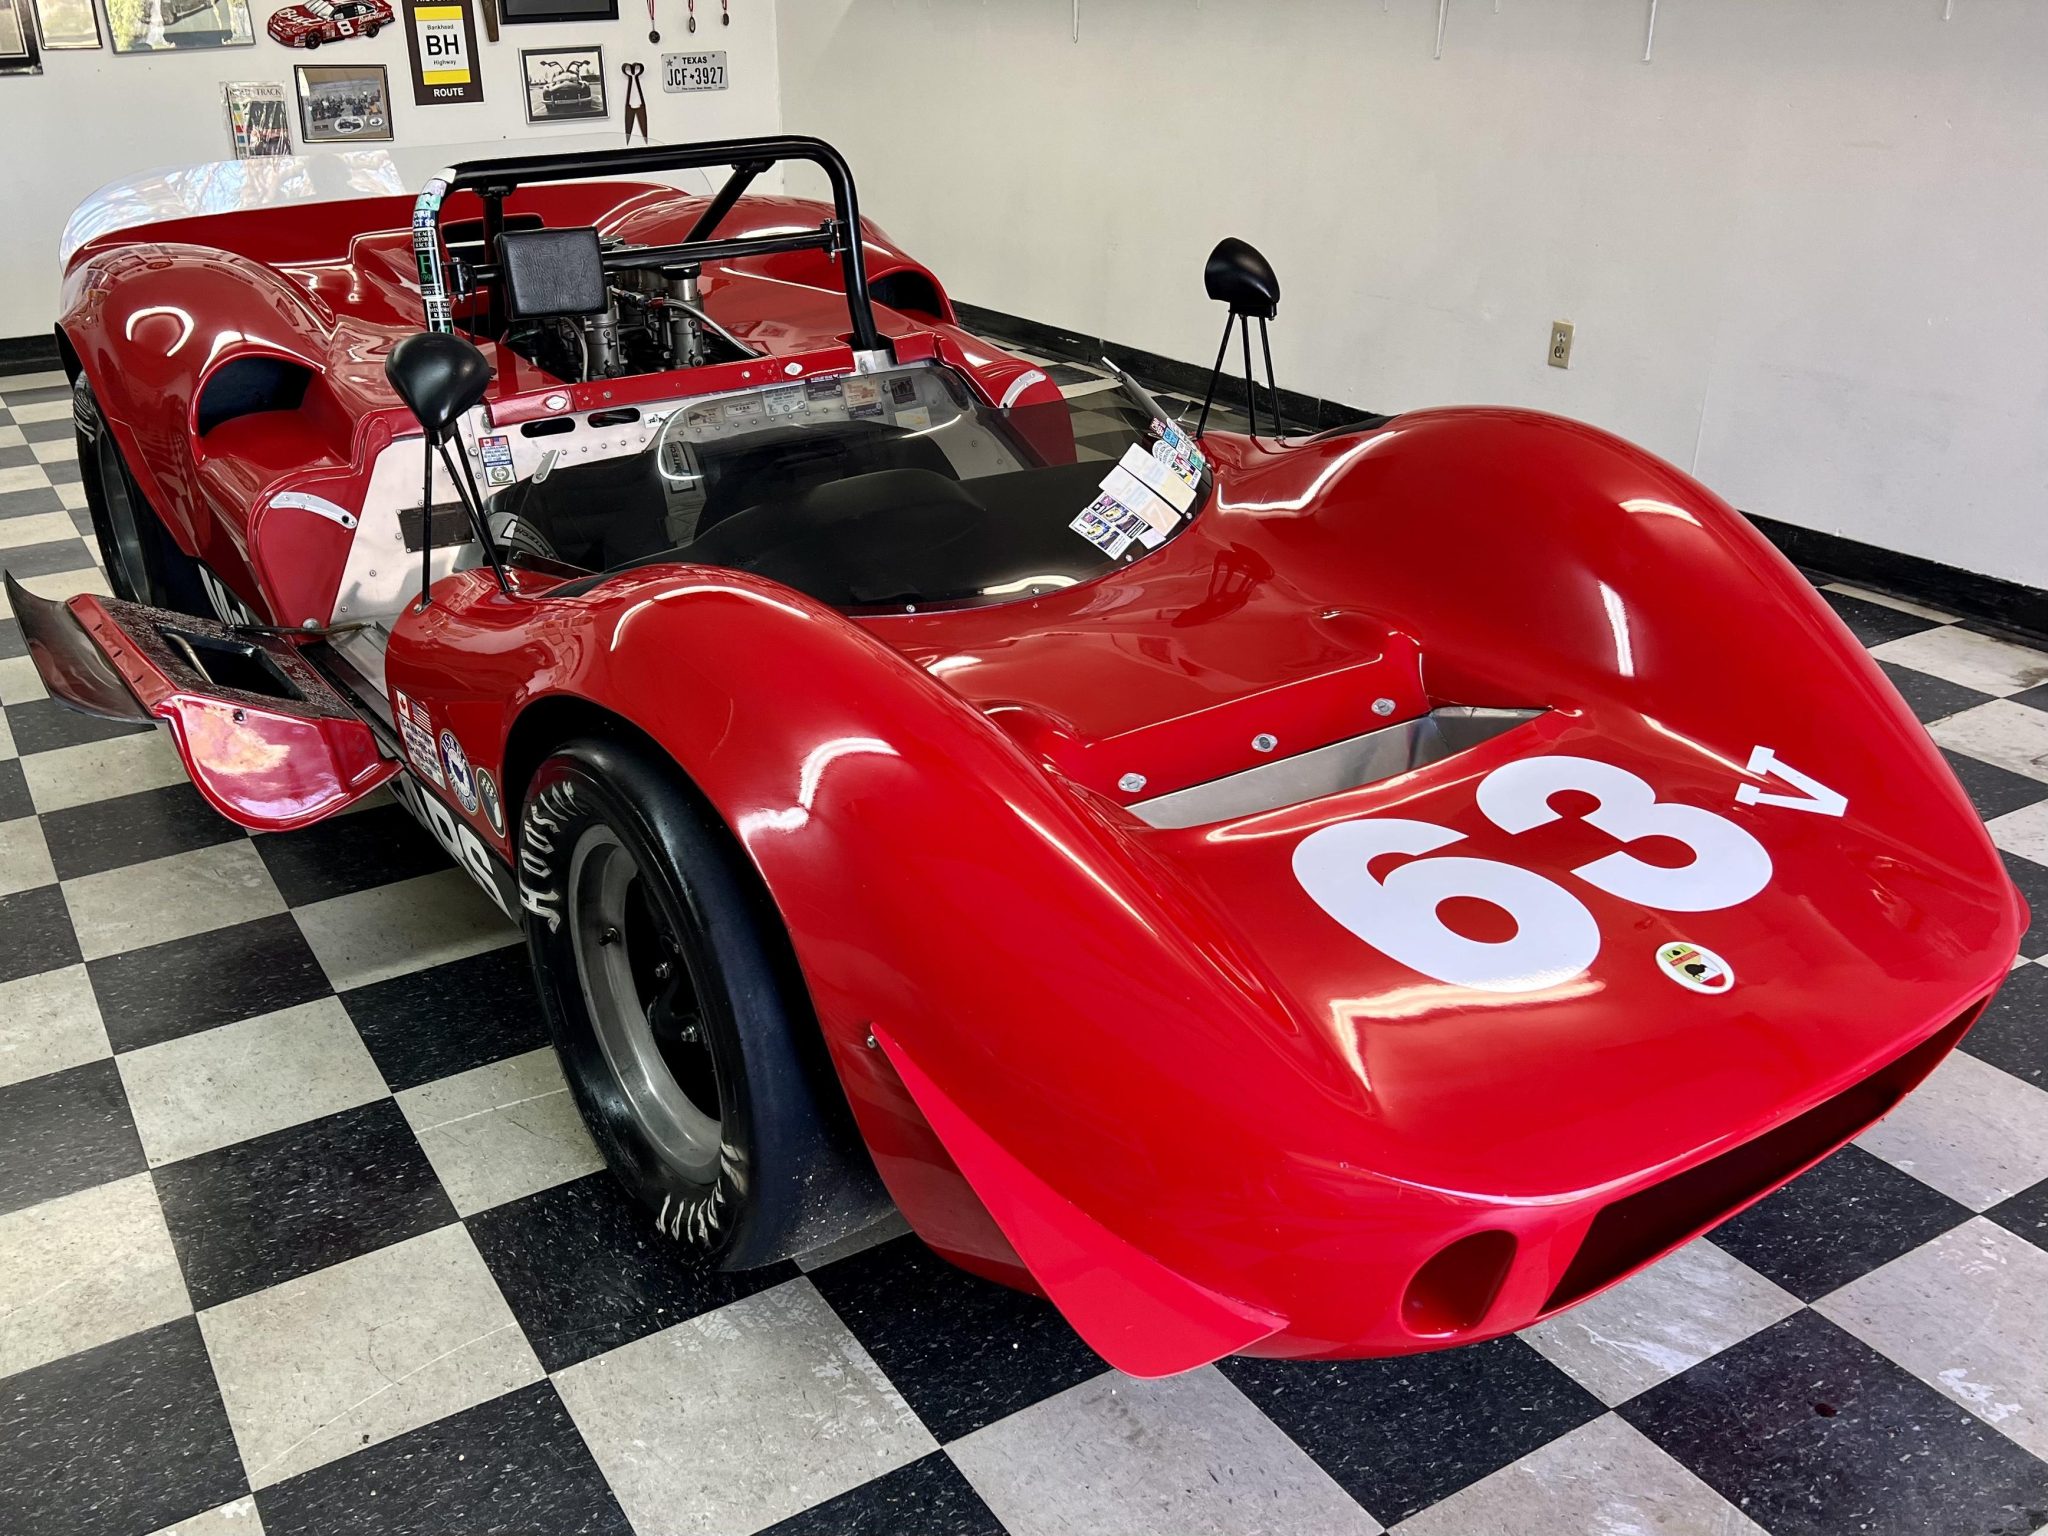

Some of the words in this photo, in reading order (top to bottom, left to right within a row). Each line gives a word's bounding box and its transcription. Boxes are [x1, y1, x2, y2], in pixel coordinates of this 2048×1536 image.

[337, 20, 354, 36] 8
[426, 34, 460, 56] BH
[433, 59, 456, 67] Highway
[682, 56, 708, 65] TEXAS
[257, 88, 282, 96] TRACK
[433, 87, 464, 97] ROUTE
[1292, 755, 1773, 992] 63
